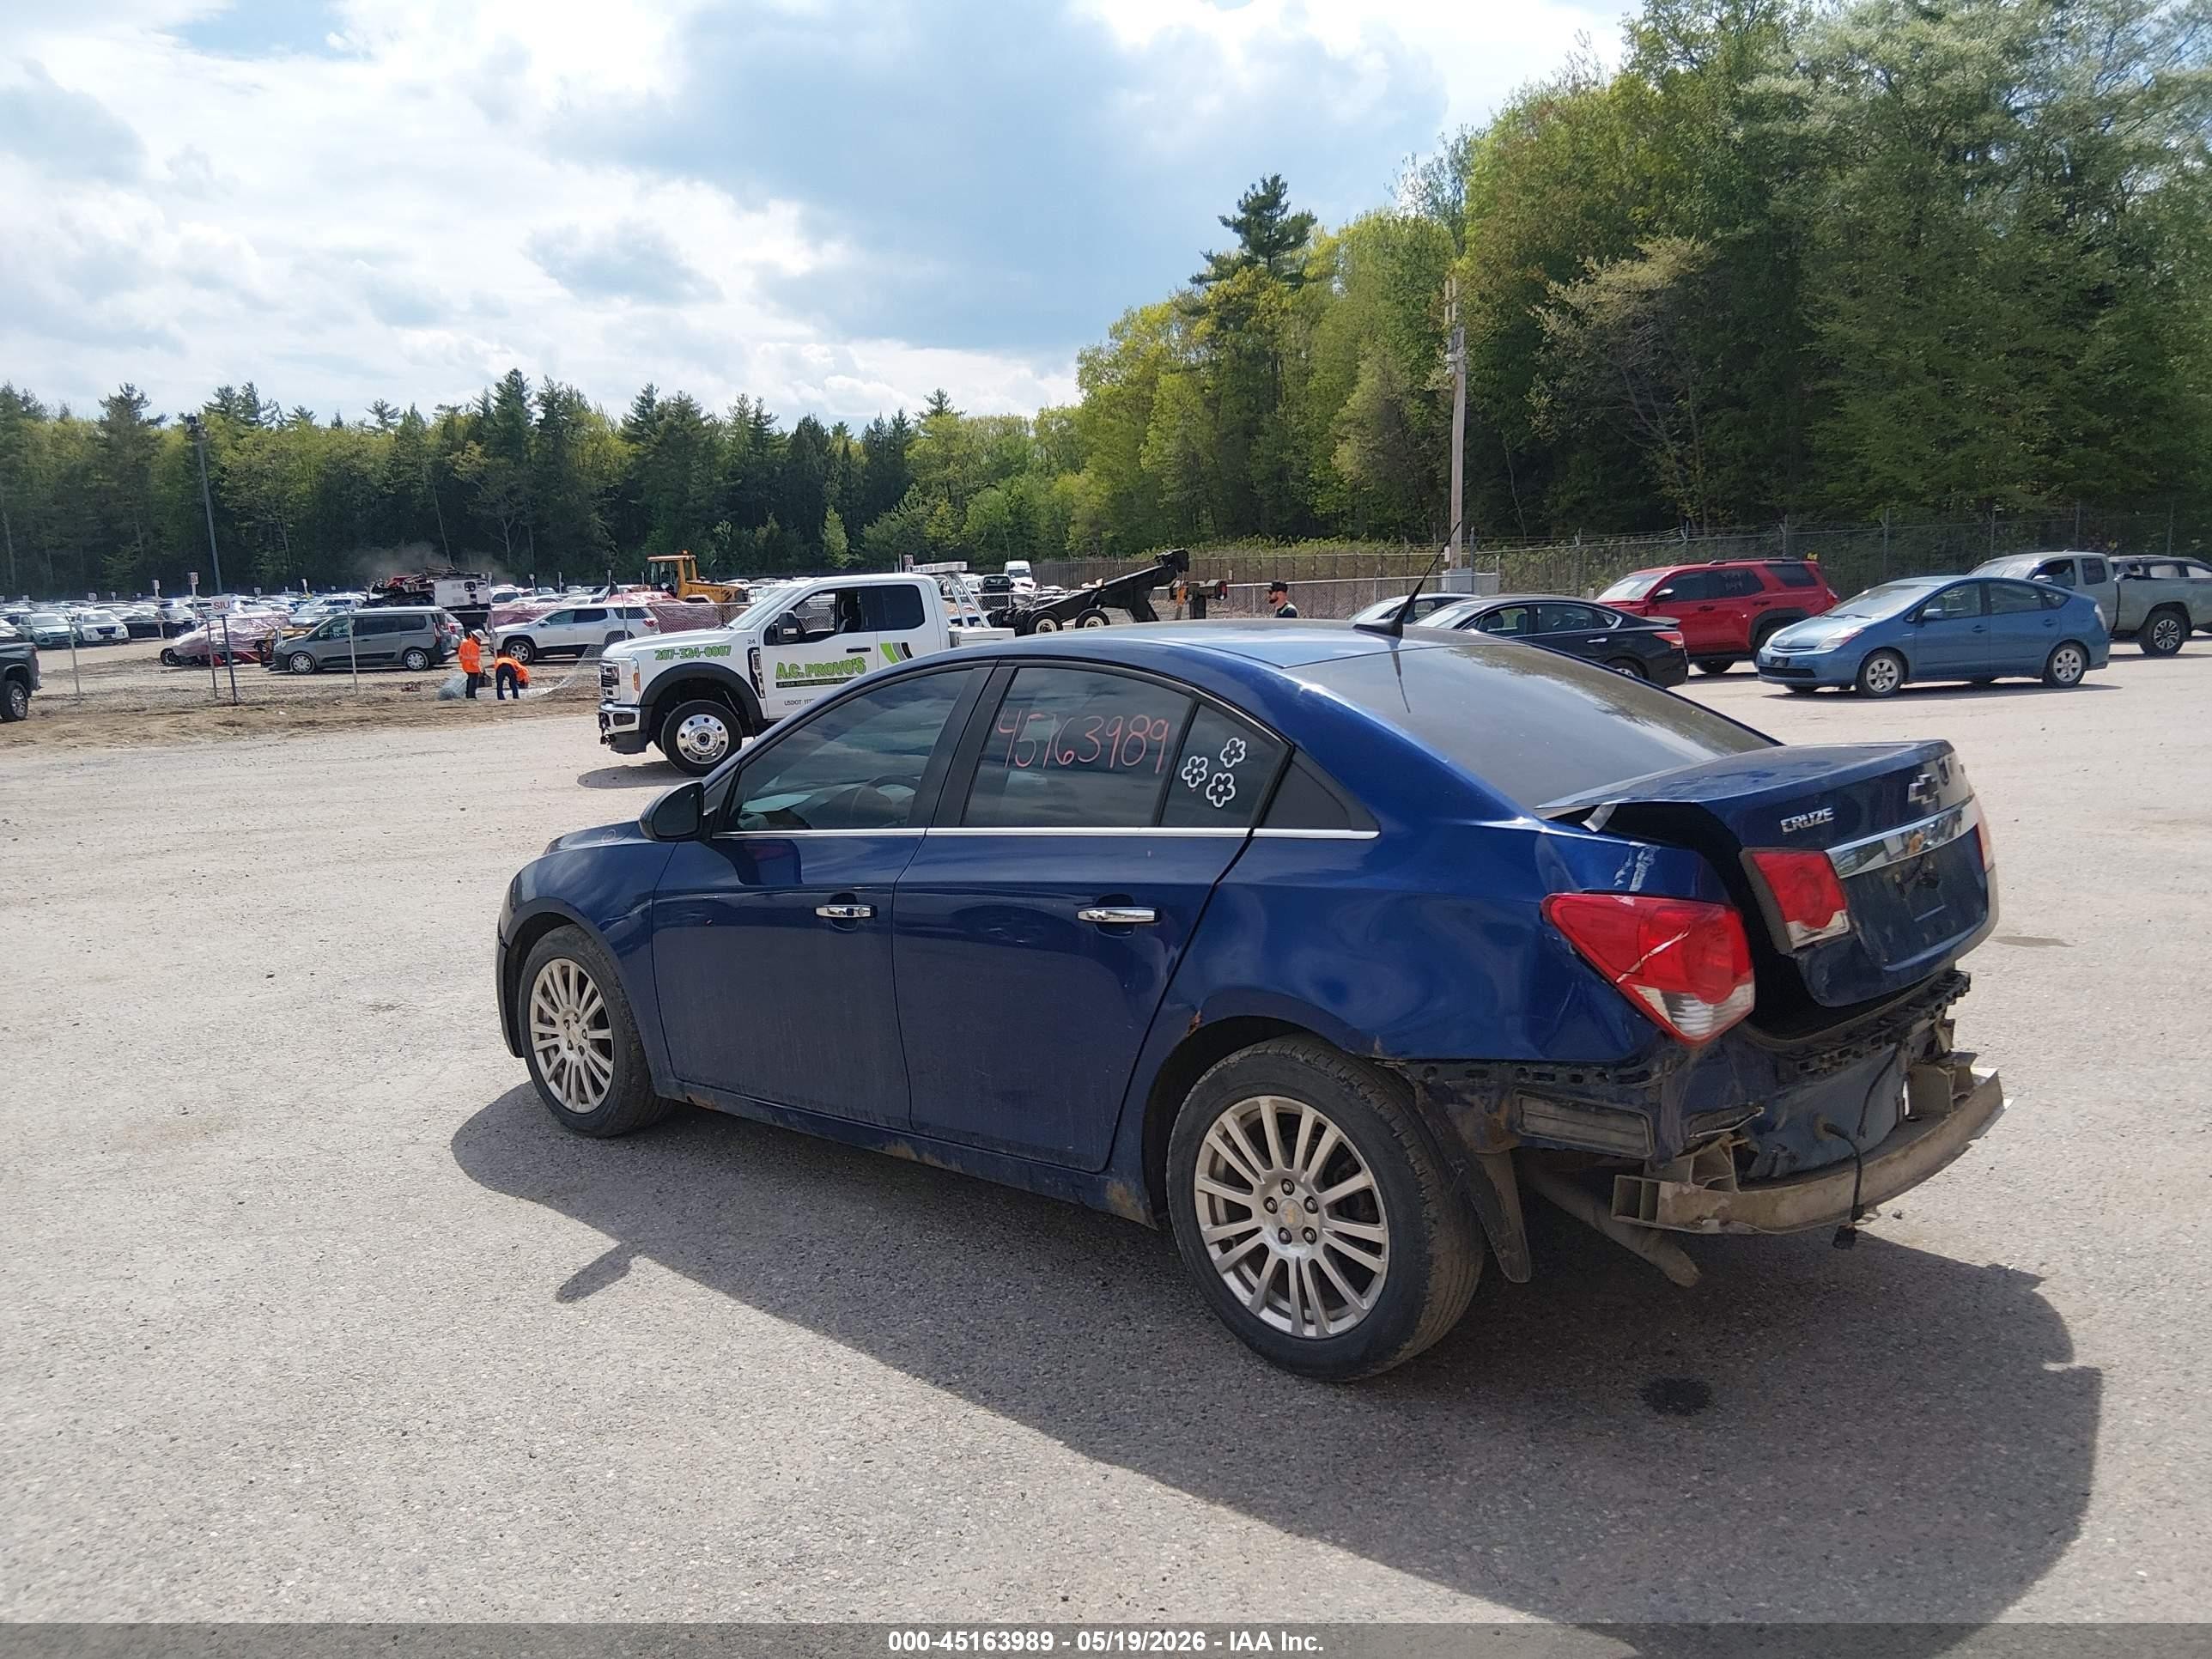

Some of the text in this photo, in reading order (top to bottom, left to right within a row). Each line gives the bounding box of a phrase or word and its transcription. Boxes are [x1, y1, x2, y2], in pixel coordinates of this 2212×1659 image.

[213, 600, 231, 611] SIU
[805, 656, 867, 678] PROVO'S
[998, 708, 1170, 775] 45163989
[1780, 807, 1834, 833] CRUZE
